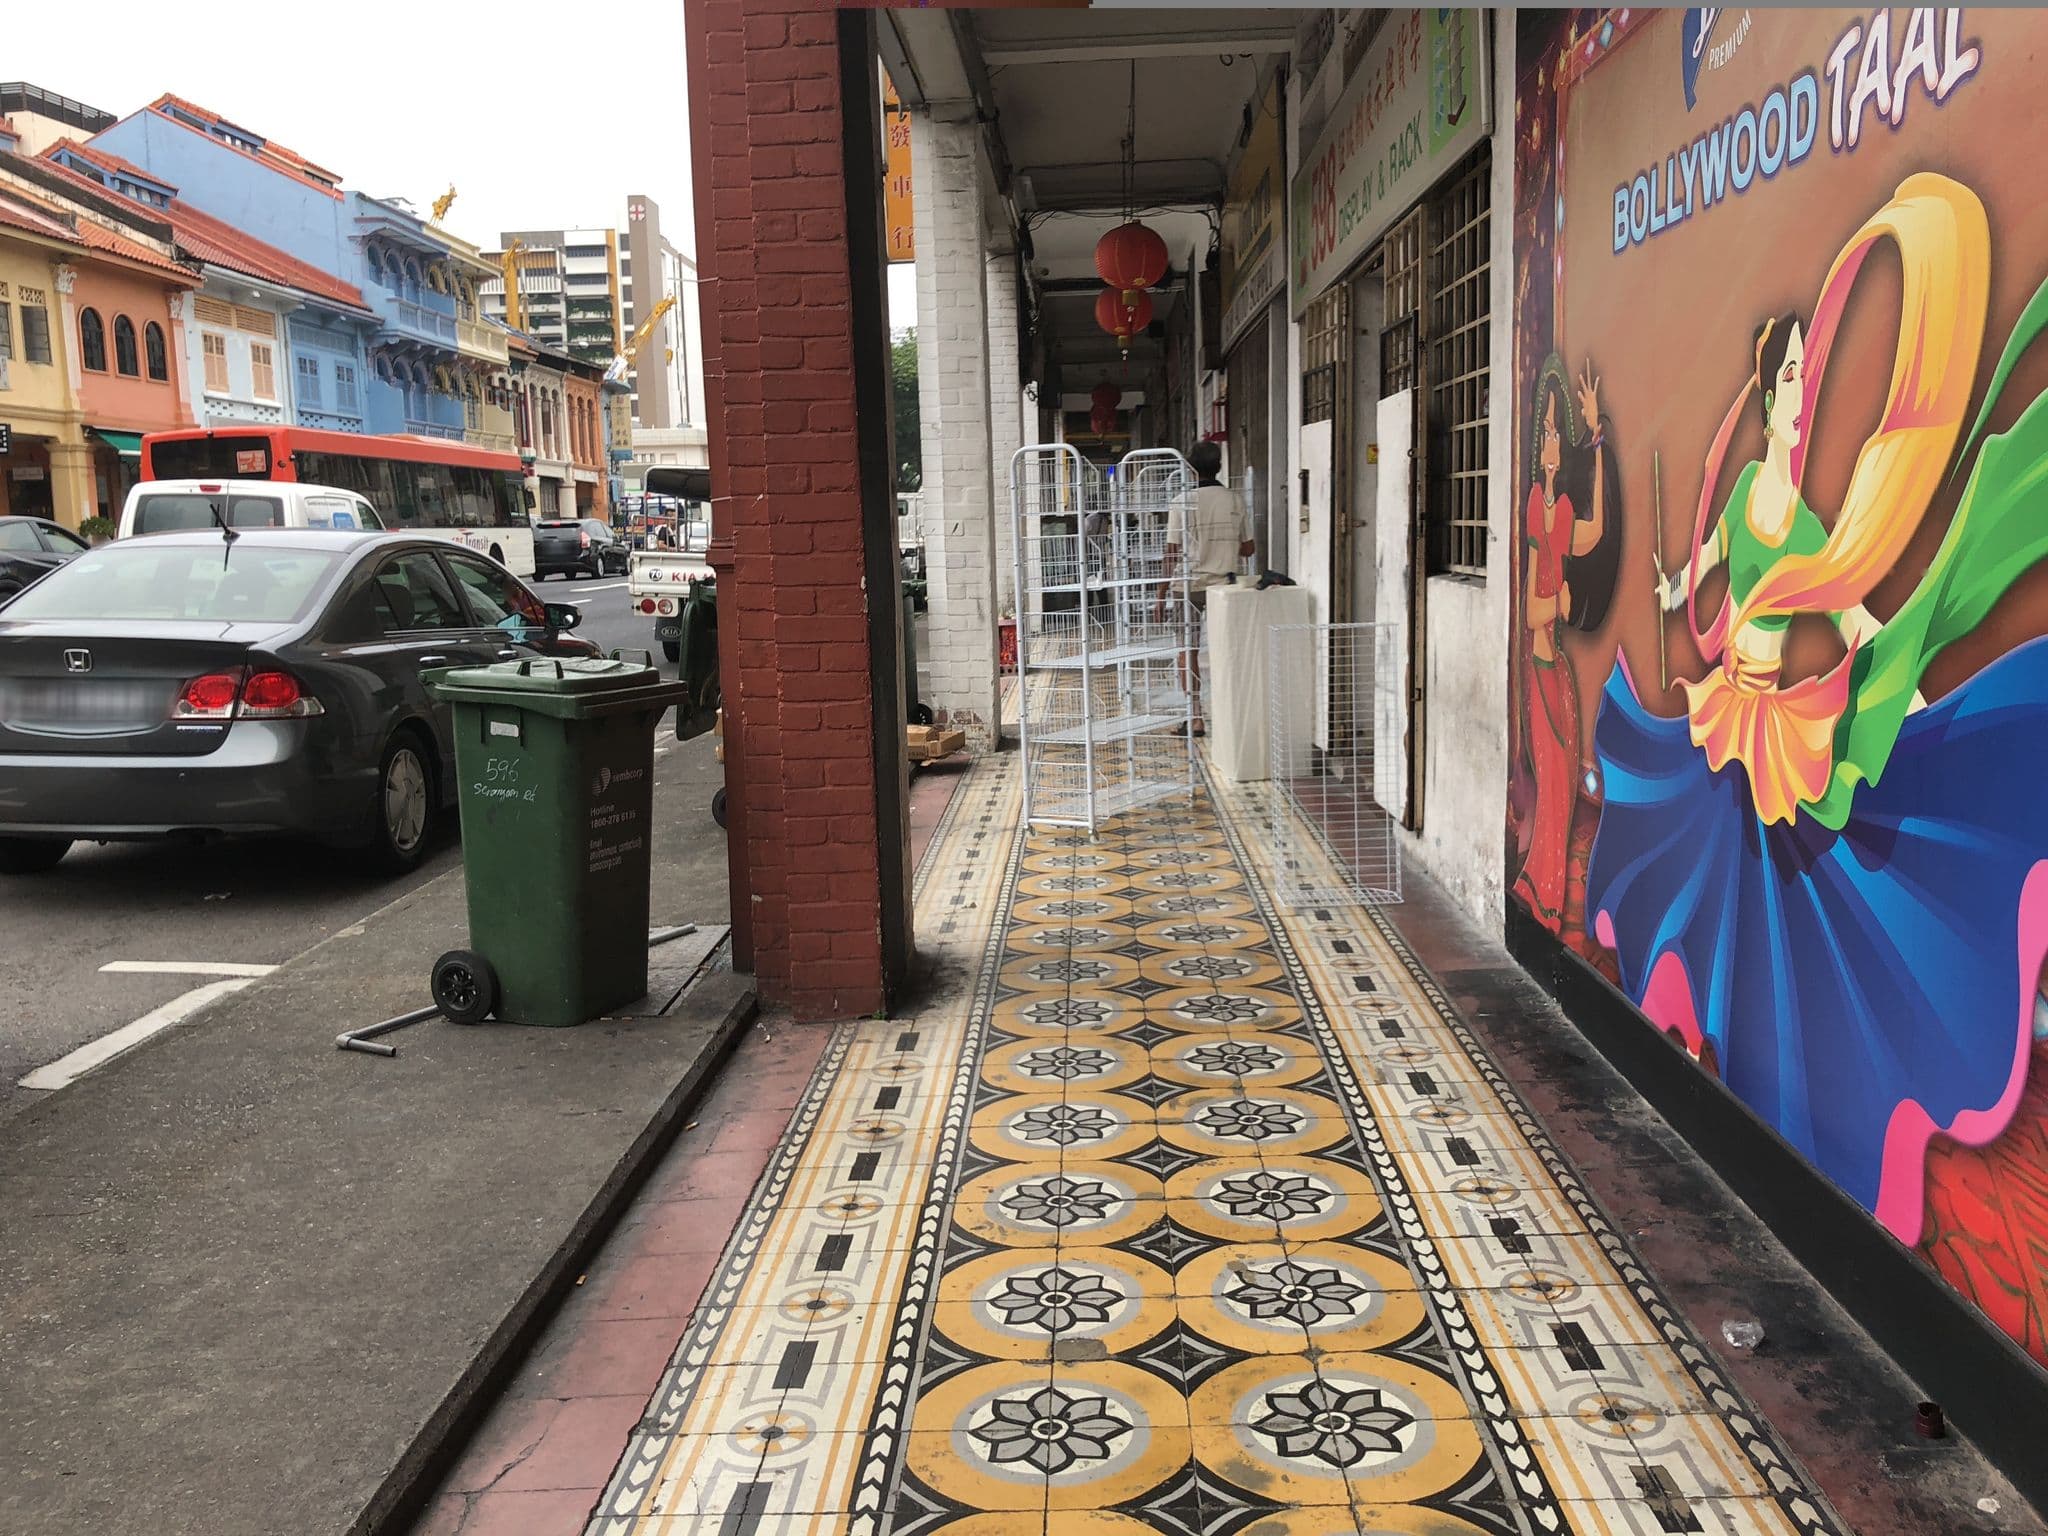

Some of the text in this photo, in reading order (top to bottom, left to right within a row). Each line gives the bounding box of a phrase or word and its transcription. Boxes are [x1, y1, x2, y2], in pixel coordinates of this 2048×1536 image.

[1708, 9, 1752, 71] PREMIUM
[1613, 73, 1818, 254] BOLLYWOOD
[1825, 8, 1979, 148] TAAL
[1338, 170, 1374, 245] DISPLAY
[1377, 160, 1386, 201] &
[1389, 110, 1424, 188] RACK
[1310, 142, 1338, 271] 598
[462, 532, 489, 551] Transit
[672, 572, 697, 582] KIA
[664, 628, 679, 637] KIA
[486, 758, 520, 782] 596
[612, 768, 643, 783] sembcorp
[590, 804, 615, 817] Hotline
